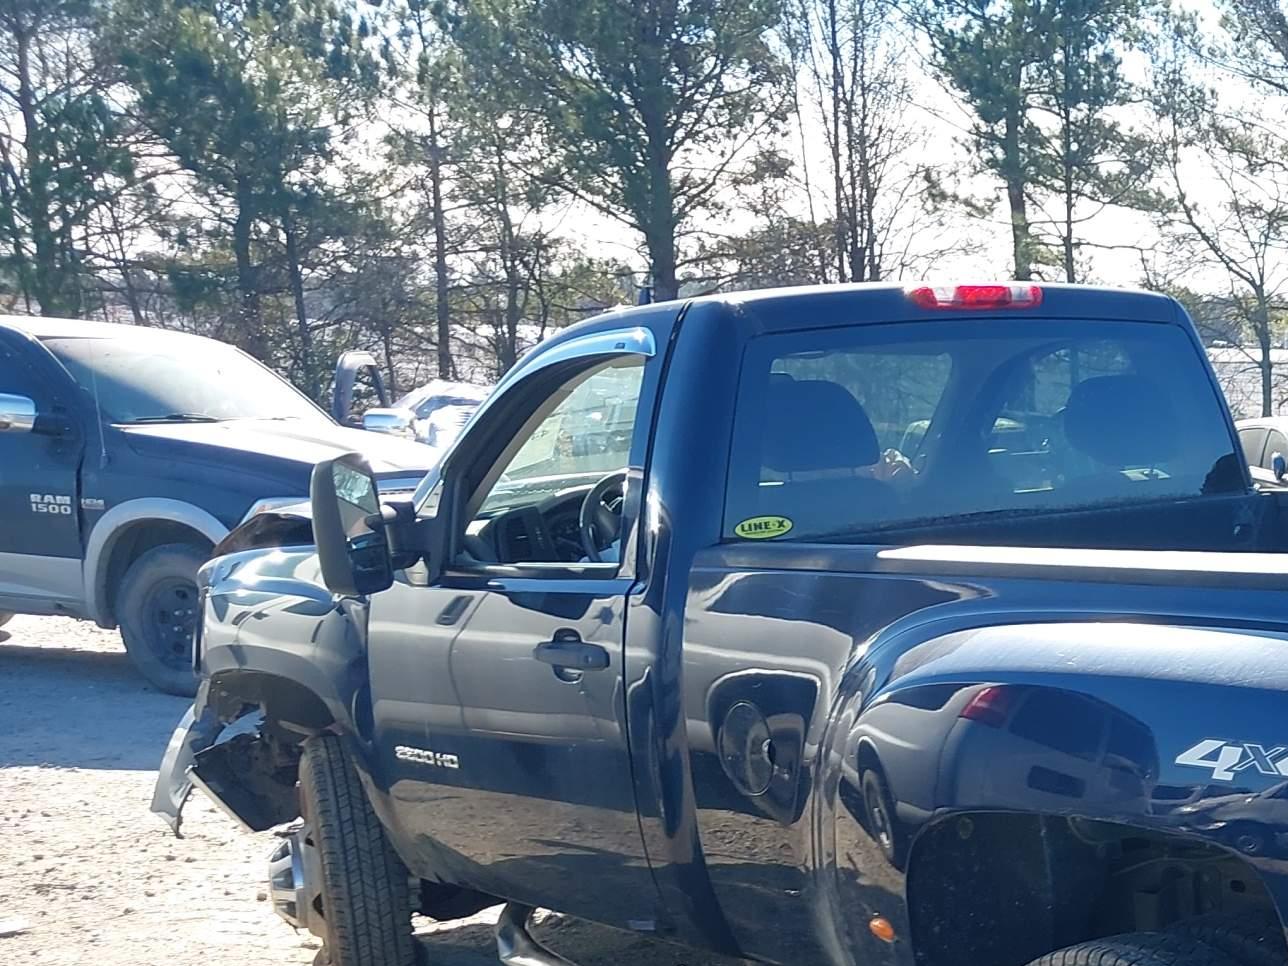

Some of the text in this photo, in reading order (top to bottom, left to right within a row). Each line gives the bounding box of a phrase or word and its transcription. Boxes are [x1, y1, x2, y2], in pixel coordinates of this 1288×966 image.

[30, 493, 71, 504] RAM
[31, 503, 72, 515] 1500
[740, 519, 786, 532] LINE-X
